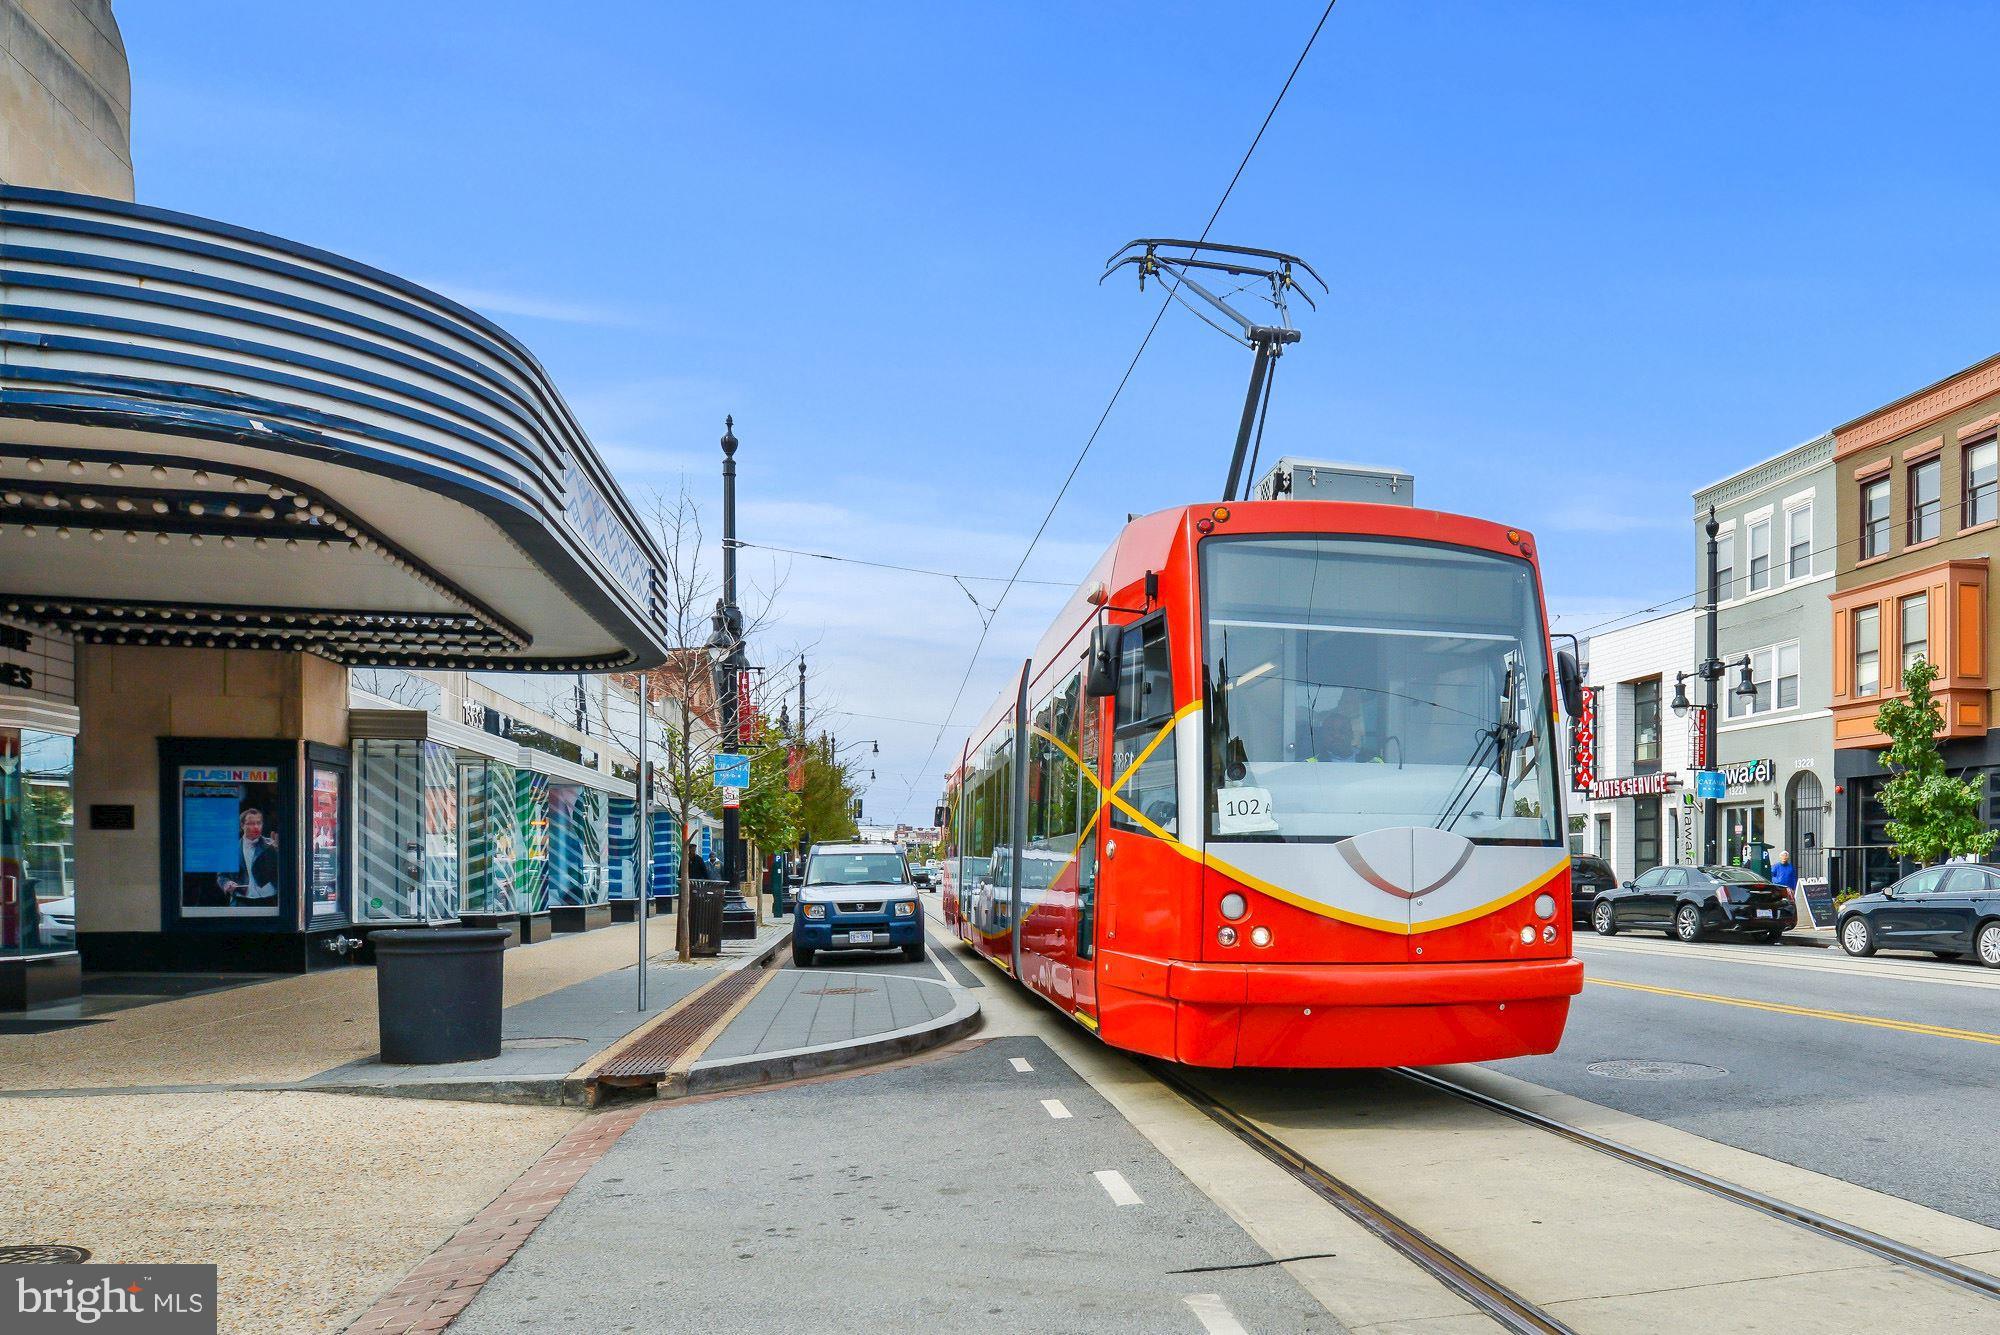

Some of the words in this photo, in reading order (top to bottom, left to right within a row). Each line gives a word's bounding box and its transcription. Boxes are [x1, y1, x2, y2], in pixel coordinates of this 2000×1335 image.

[1580, 689, 1591, 784] PIZZA
[1593, 780, 1620, 798] PARTS
[1627, 775, 1666, 796] SERVICE
[1226, 799, 1260, 817] 102
